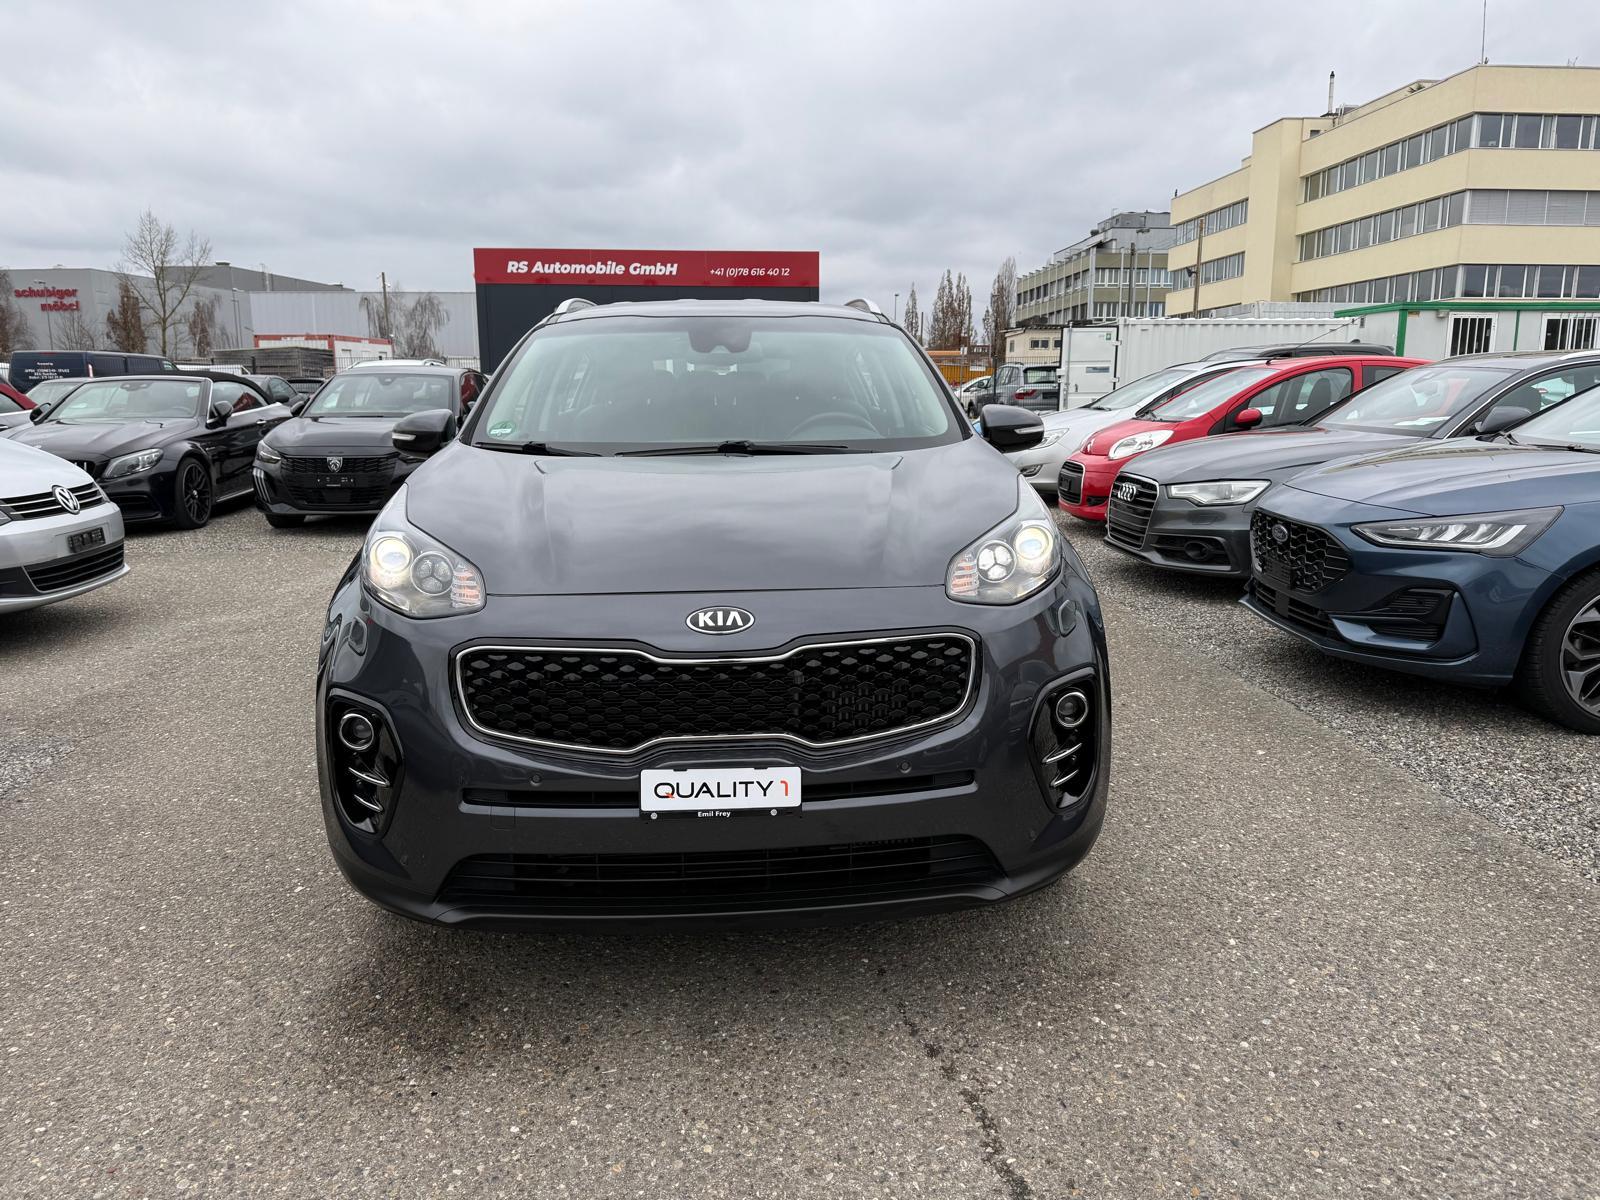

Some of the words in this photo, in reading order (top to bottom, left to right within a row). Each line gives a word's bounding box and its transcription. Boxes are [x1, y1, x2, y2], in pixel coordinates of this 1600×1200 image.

[507, 261, 528, 274] RS
[531, 260, 625, 275] Automobile
[629, 263, 678, 275] GmbH
[710, 268, 724, 276] +41
[726, 267, 749, 277] (0)78
[751, 268, 765, 276] 616
[767, 268, 779, 276] 40
[781, 268, 790, 276] 12
[698, 611, 744, 627] KIA
